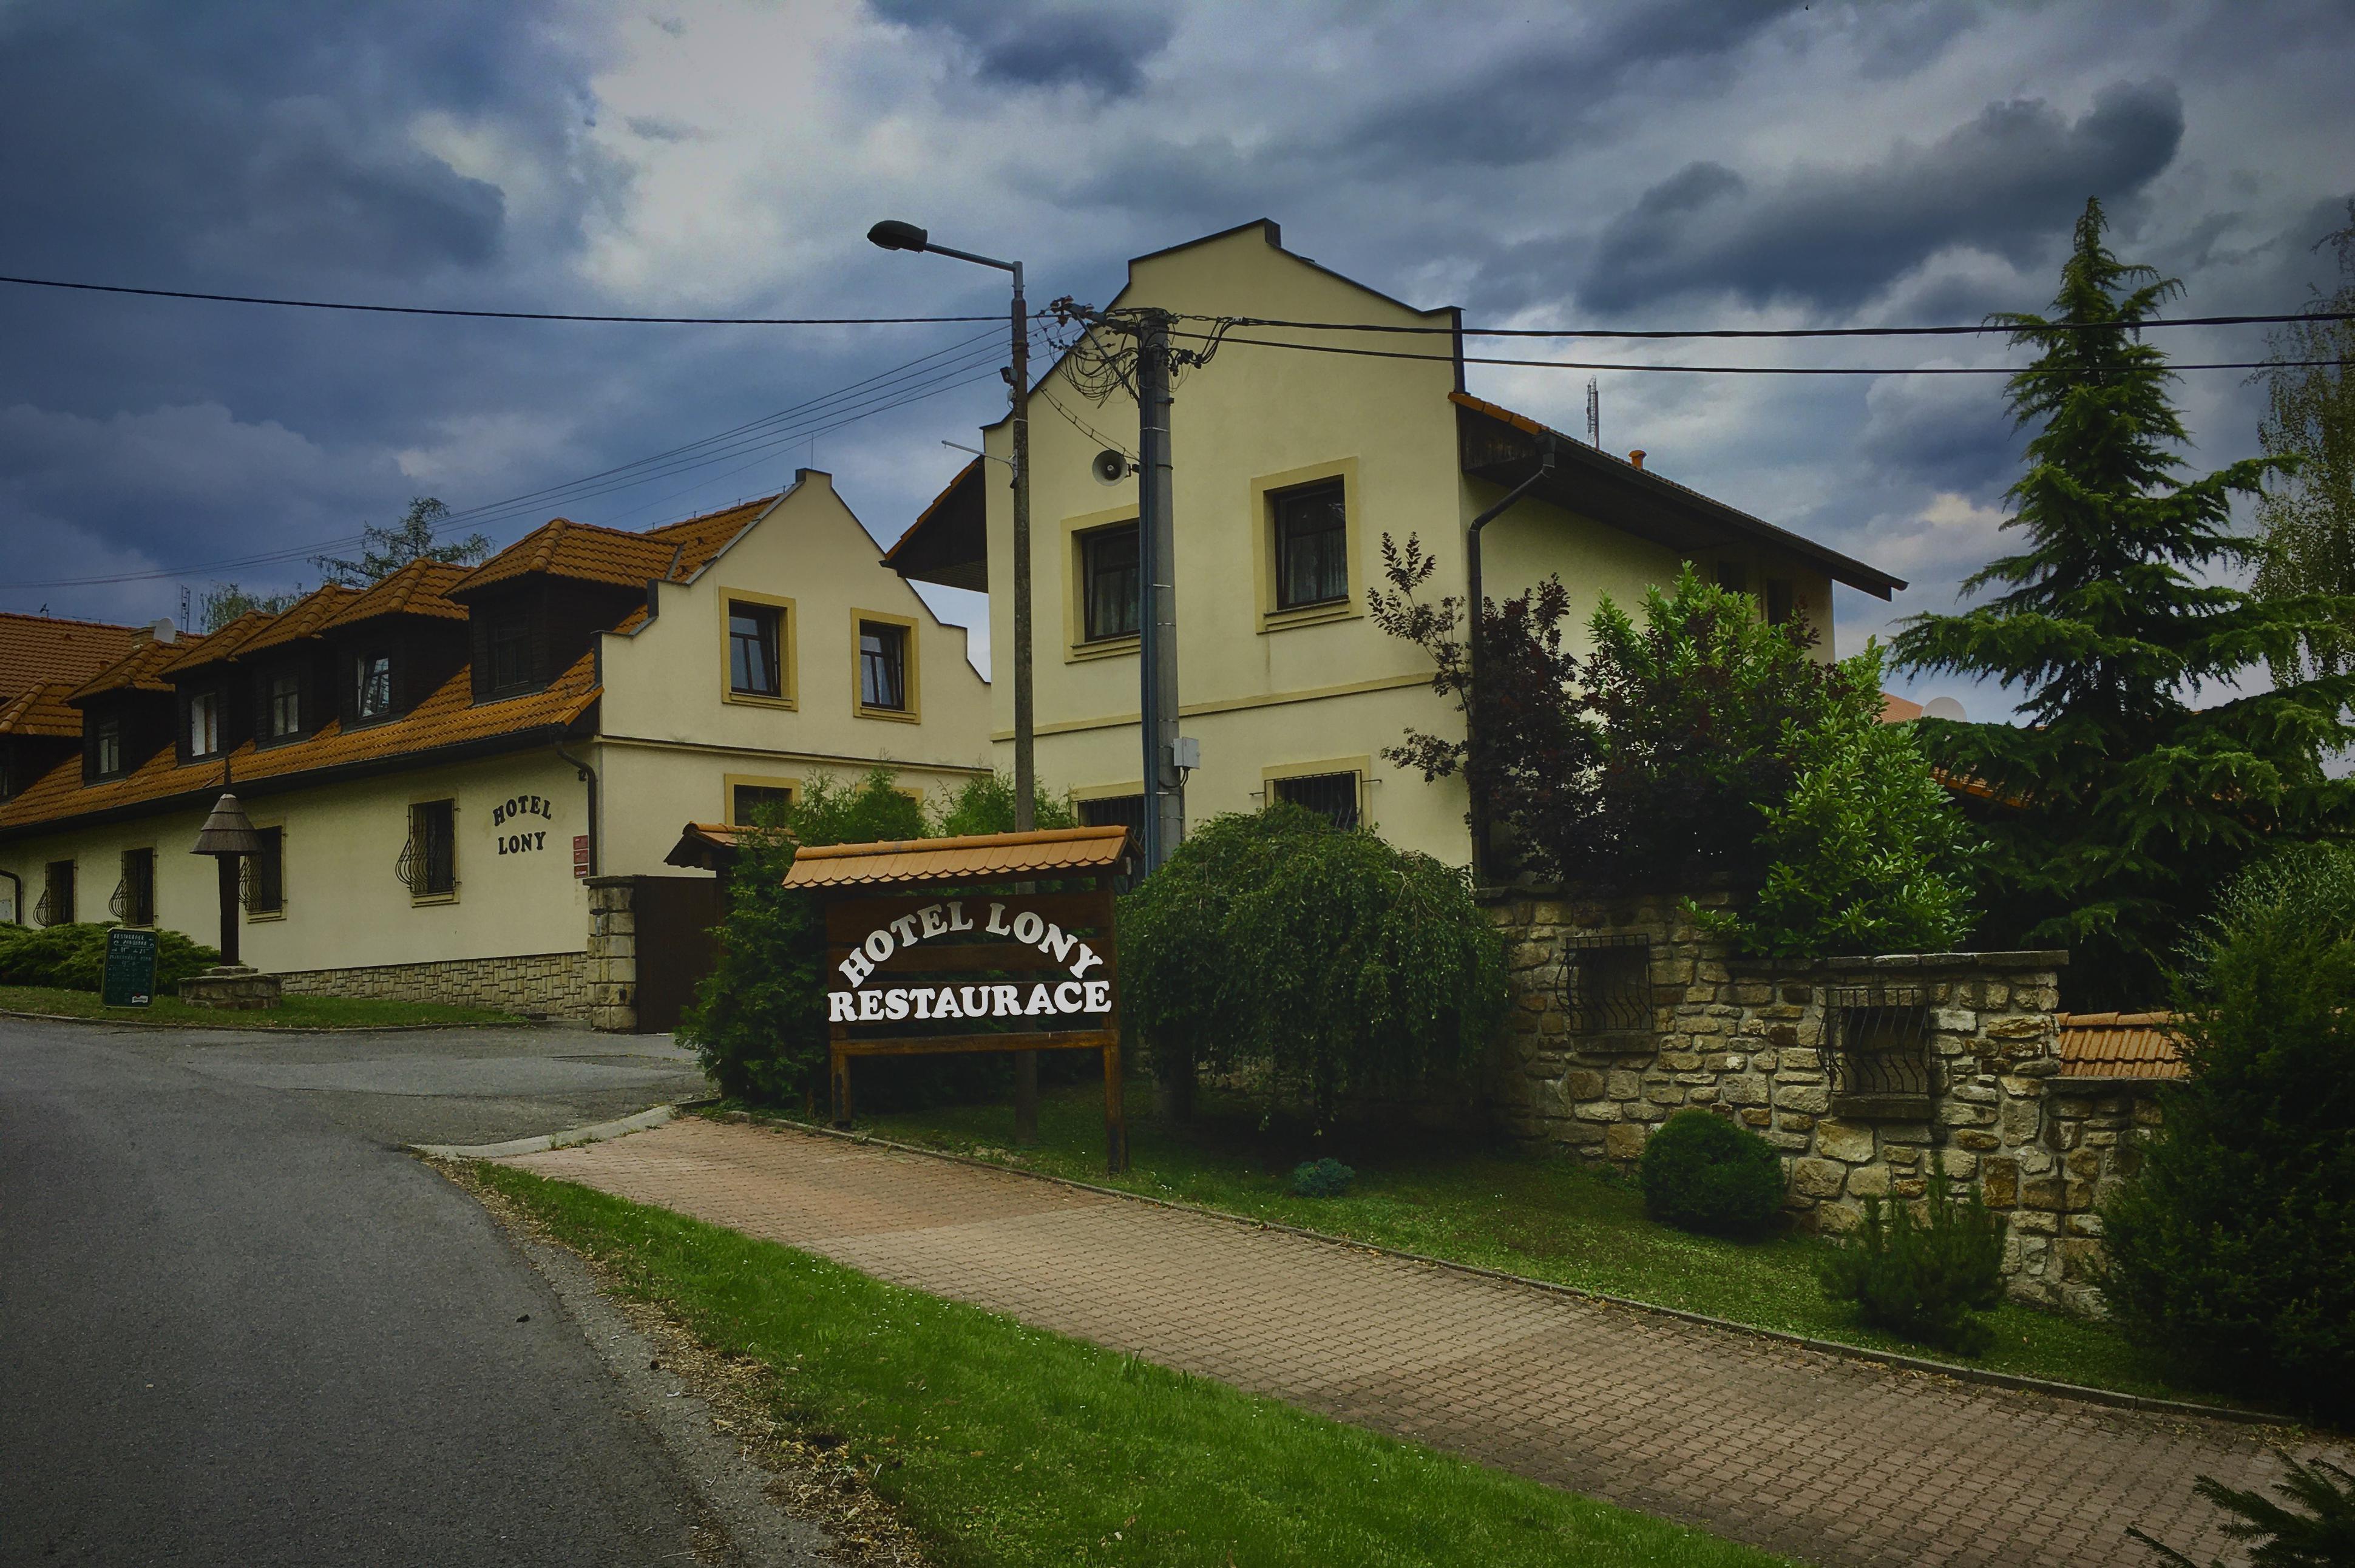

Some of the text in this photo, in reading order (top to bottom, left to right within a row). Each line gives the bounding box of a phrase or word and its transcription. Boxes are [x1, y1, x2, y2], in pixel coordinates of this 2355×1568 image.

[493, 795, 551, 826] HOTEL
[498, 831, 546, 854] LONY
[838, 901, 1103, 988] HOTEL LONY
[827, 981, 1112, 1022] RESTAURACE
